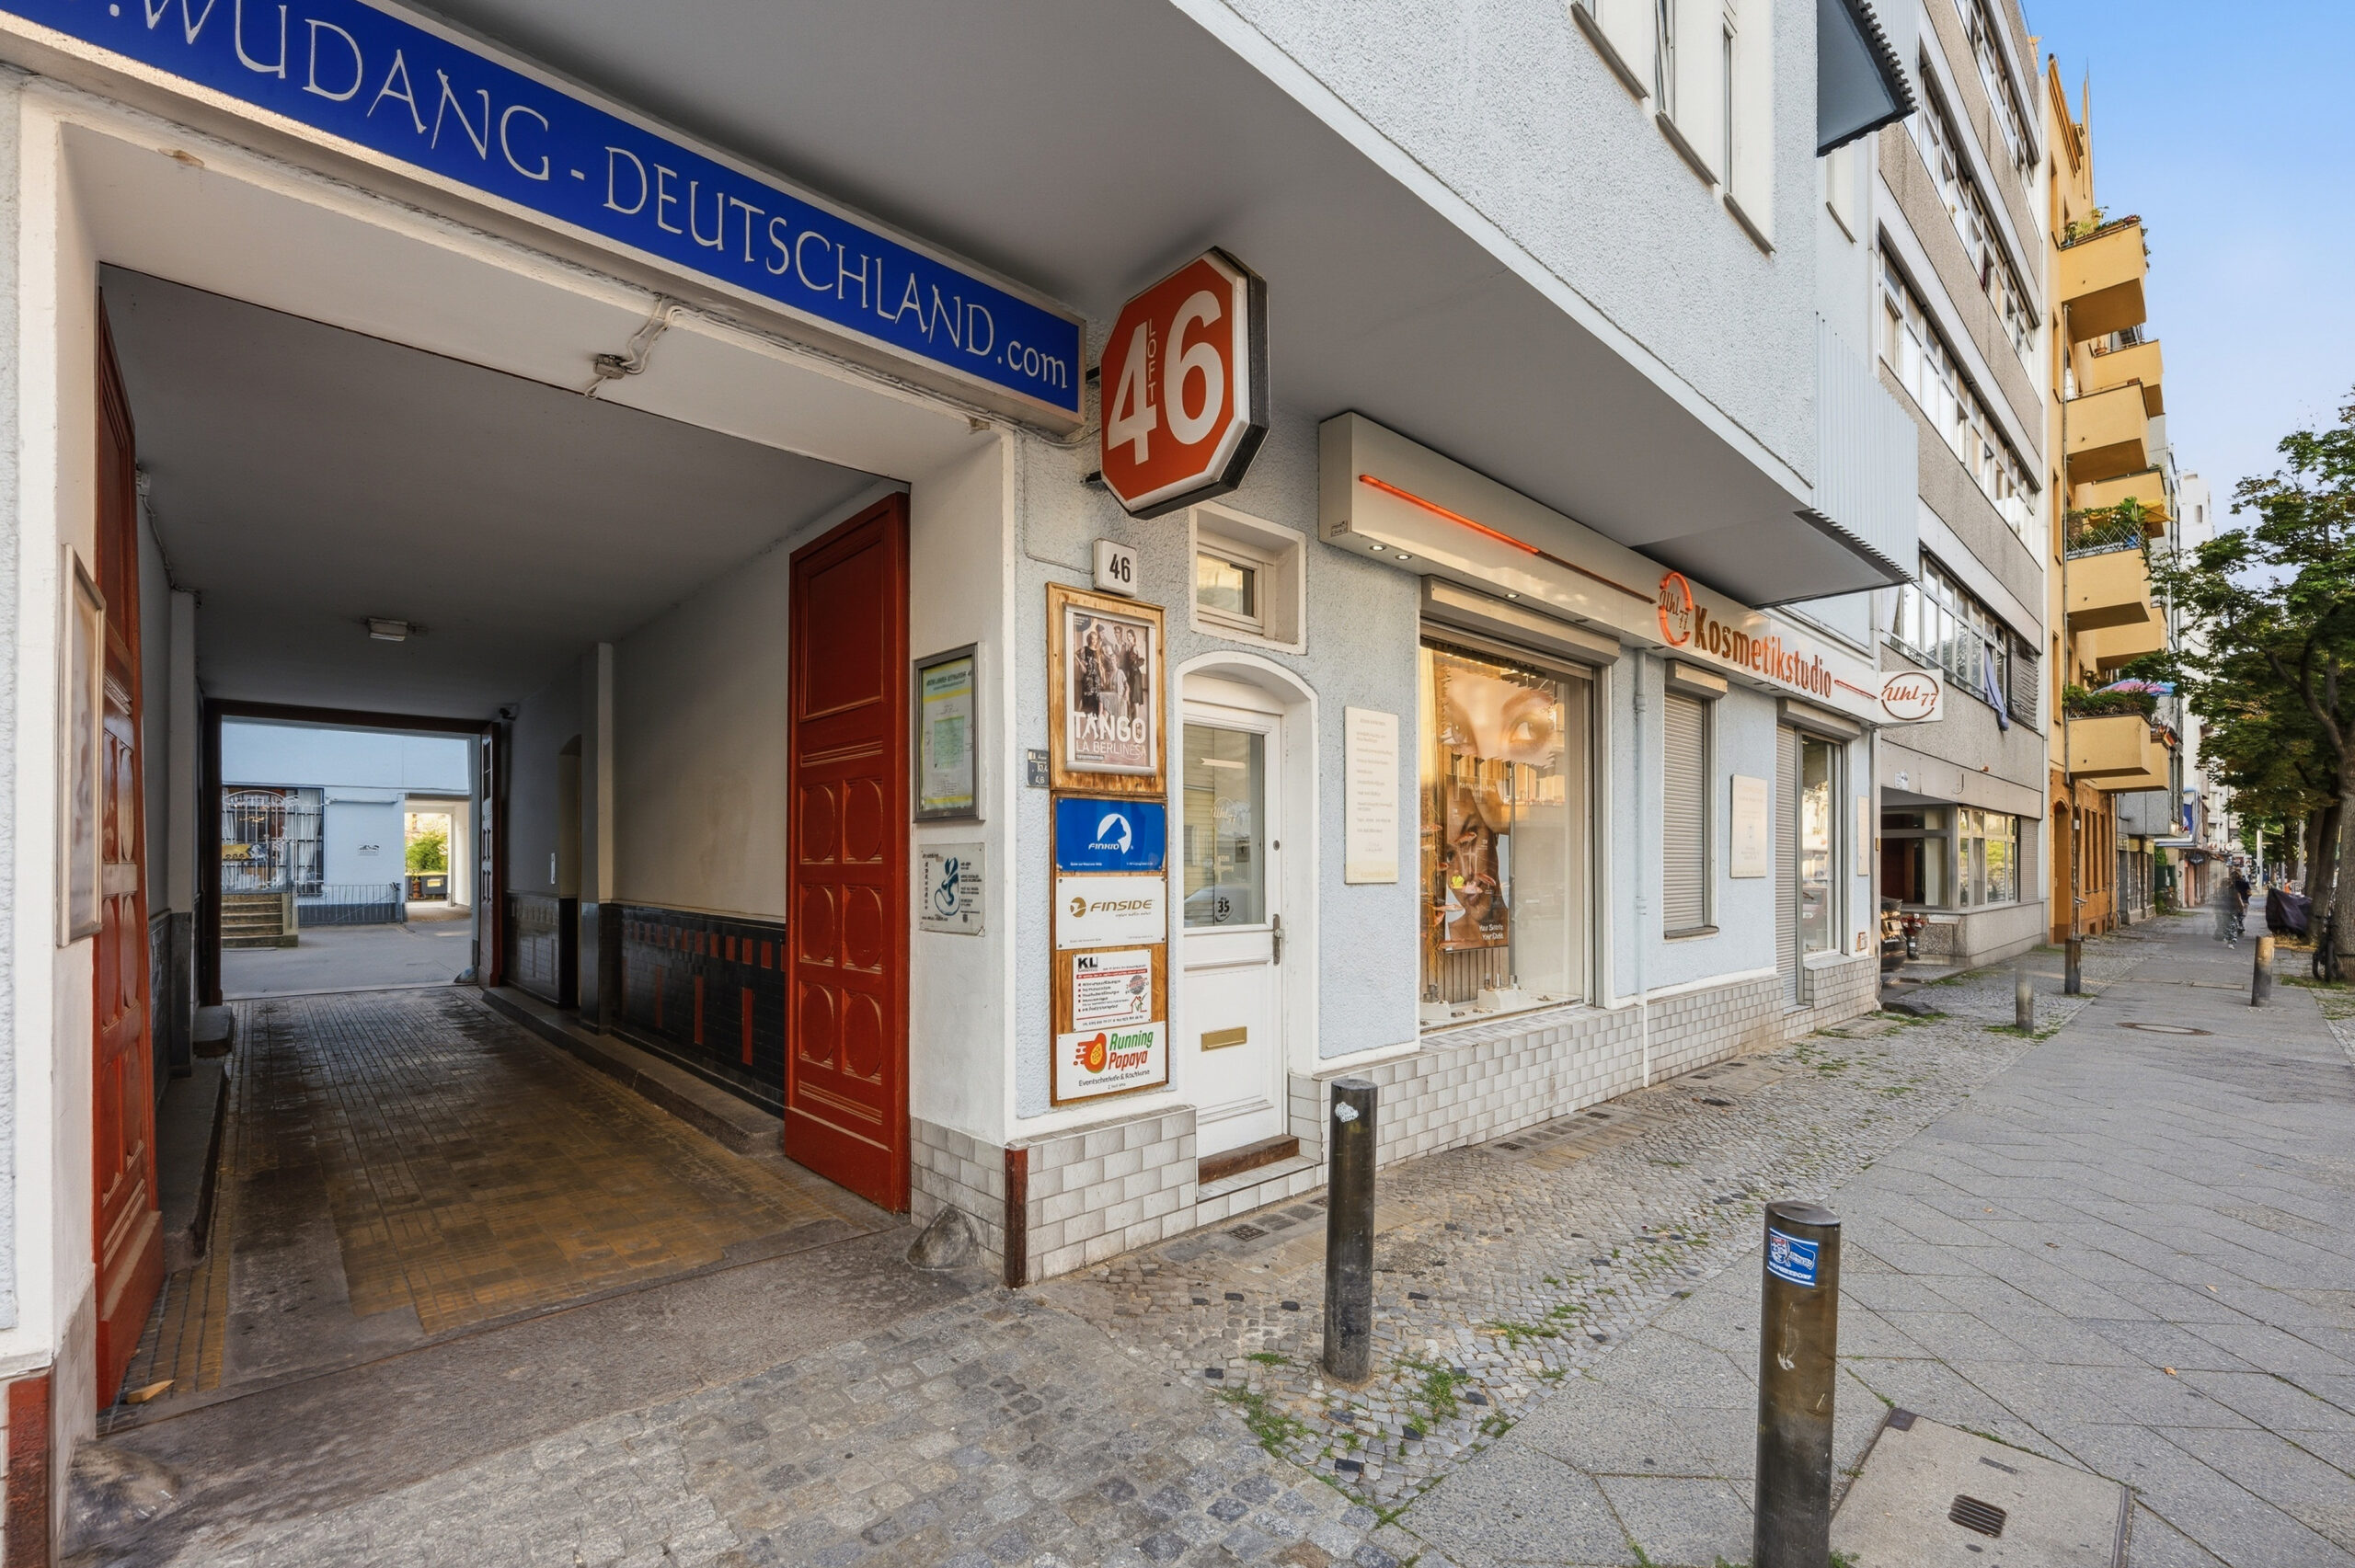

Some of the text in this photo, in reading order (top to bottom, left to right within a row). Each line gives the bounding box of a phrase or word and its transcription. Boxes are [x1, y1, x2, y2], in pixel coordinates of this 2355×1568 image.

[1146, 318, 1158, 404] LOFT
[1108, 290, 1224, 465] 46
[1109, 554, 1132, 583] 46
[1694, 604, 1832, 699] Kosmetikstudio
[1881, 685, 1938, 707] Uhl 77
[1074, 711, 1147, 745] TANGO
[1076, 739, 1090, 753] LA
[1093, 741, 1147, 759] BERLINESA
[1090, 898, 1154, 912] FINSIDE
[1217, 899, 1231, 914] 35
[1077, 956, 1098, 969] KL
[1109, 1030, 1155, 1052] Running
[1108, 1050, 1149, 1071] Papaya
